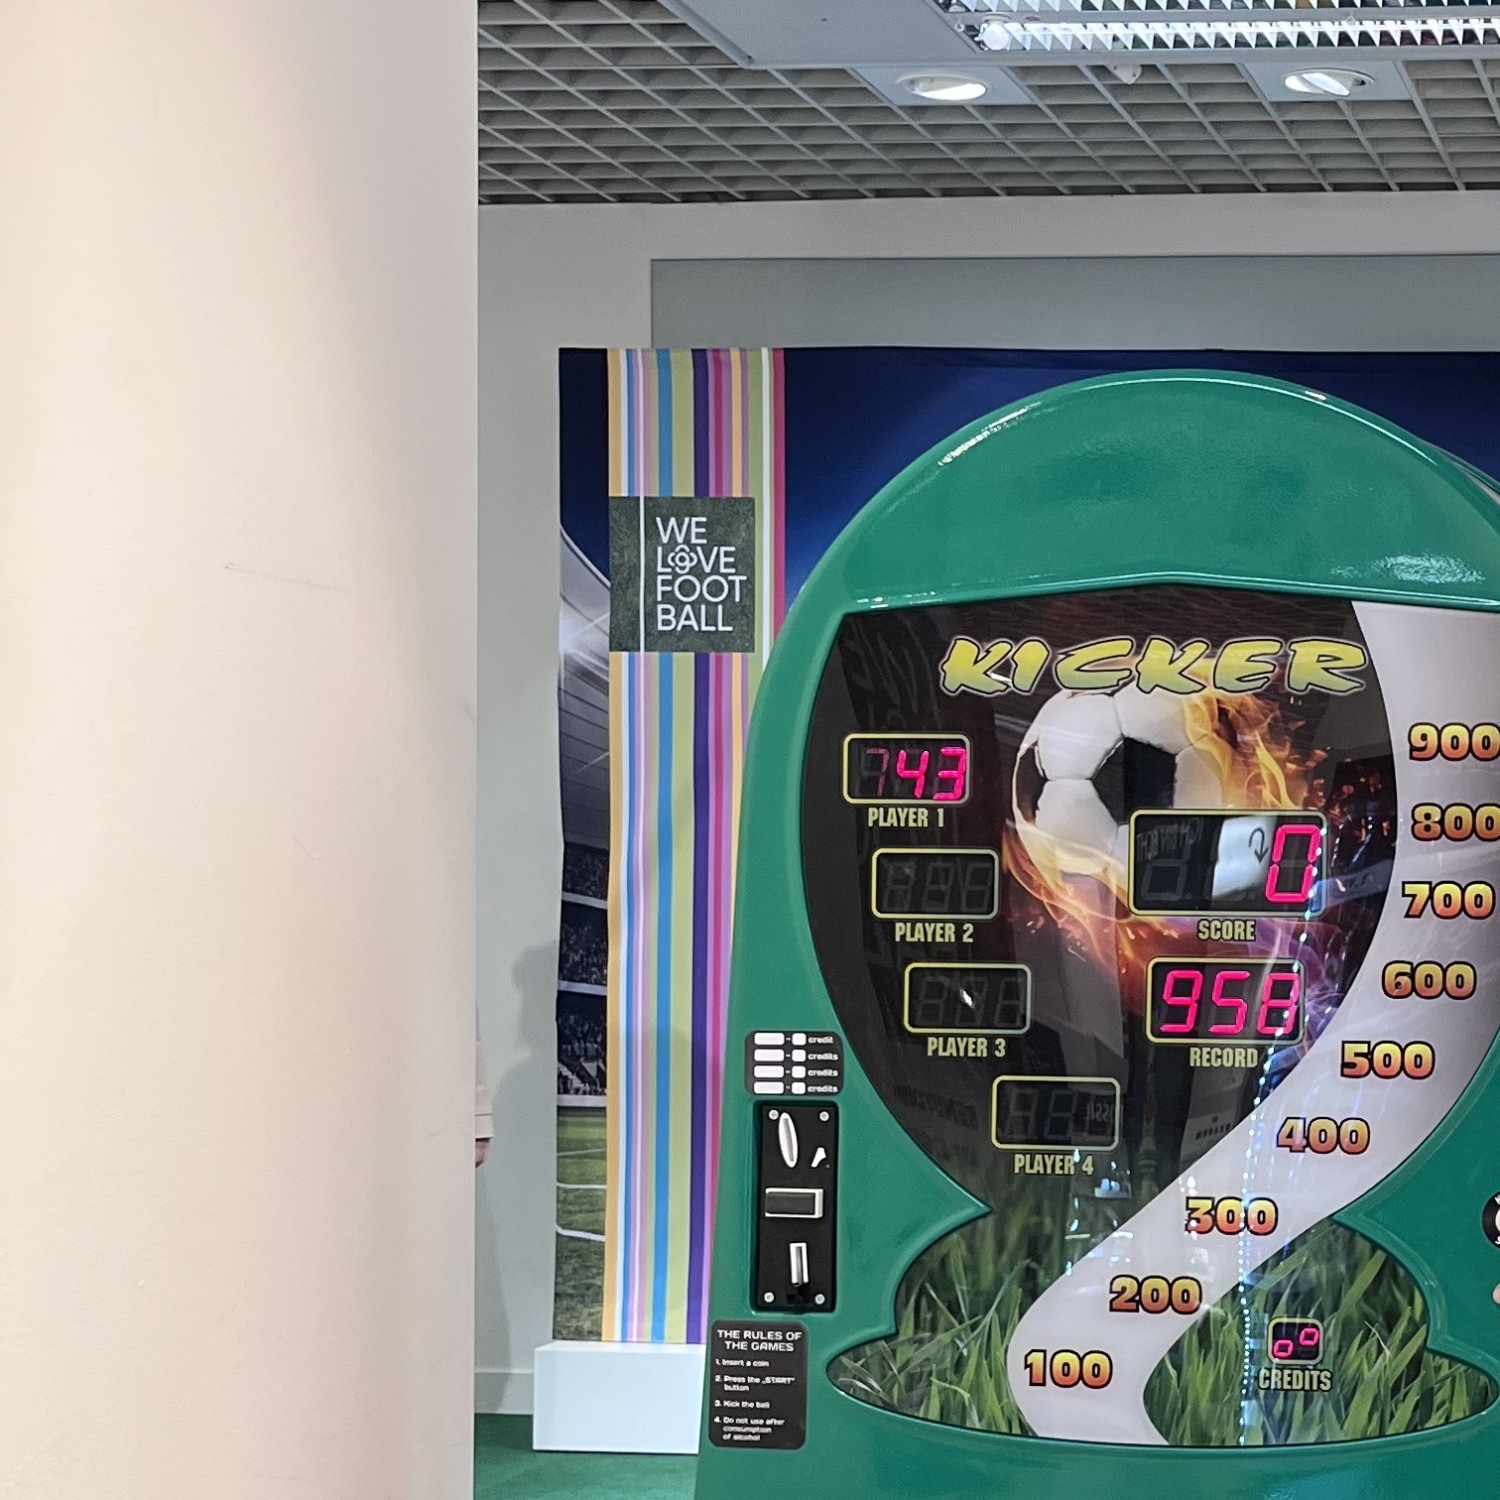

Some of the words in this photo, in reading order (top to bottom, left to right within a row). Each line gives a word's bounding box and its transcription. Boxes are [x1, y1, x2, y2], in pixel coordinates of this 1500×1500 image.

[655, 517, 707, 544] WE
[656, 545, 736, 581] LOVE
[656, 575, 747, 602] FOOT
[656, 604, 733, 631] BALL
[940, 636, 1368, 695] KICKER
[868, 807, 929, 827] PLAYER
[937, 808, 944, 827] 1
[1265, 824, 1321, 903] 0
[1402, 881, 1495, 919] 700
[895, 922, 958, 943] PLAYER
[962, 923, 974, 943] 2
[1198, 920, 1256, 941] SCORE
[1382, 960, 1477, 1000] 600
[1159, 969, 1300, 1035] 958
[808, 1036, 834, 1044] credit
[927, 1037, 989, 1058] PLAYER
[994, 1038, 1006, 1058] 3
[1189, 1047, 1258, 1068] RECORD
[1340, 1040, 1436, 1079] 500
[808, 1069, 839, 1077] credits
[807, 1085, 839, 1093] credits
[1276, 1116, 1371, 1155] 400
[1014, 1154, 1075, 1174] PLAYER
[1082, 1155, 1094, 1175] 4
[1184, 1197, 1279, 1236] 300
[1109, 1275, 1202, 1314] 200
[717, 1329, 740, 1339] THE
[743, 1330, 782, 1340] RULES
[786, 1332, 802, 1341] OF
[725, 1341, 748, 1351] THE
[751, 1342, 794, 1352] GAMES
[724, 1375, 746, 1383] Press
[1025, 1349, 1113, 1389] 100
[1258, 1369, 1332, 1391] CREDITS
[723, 1400, 740, 1408] Kick
